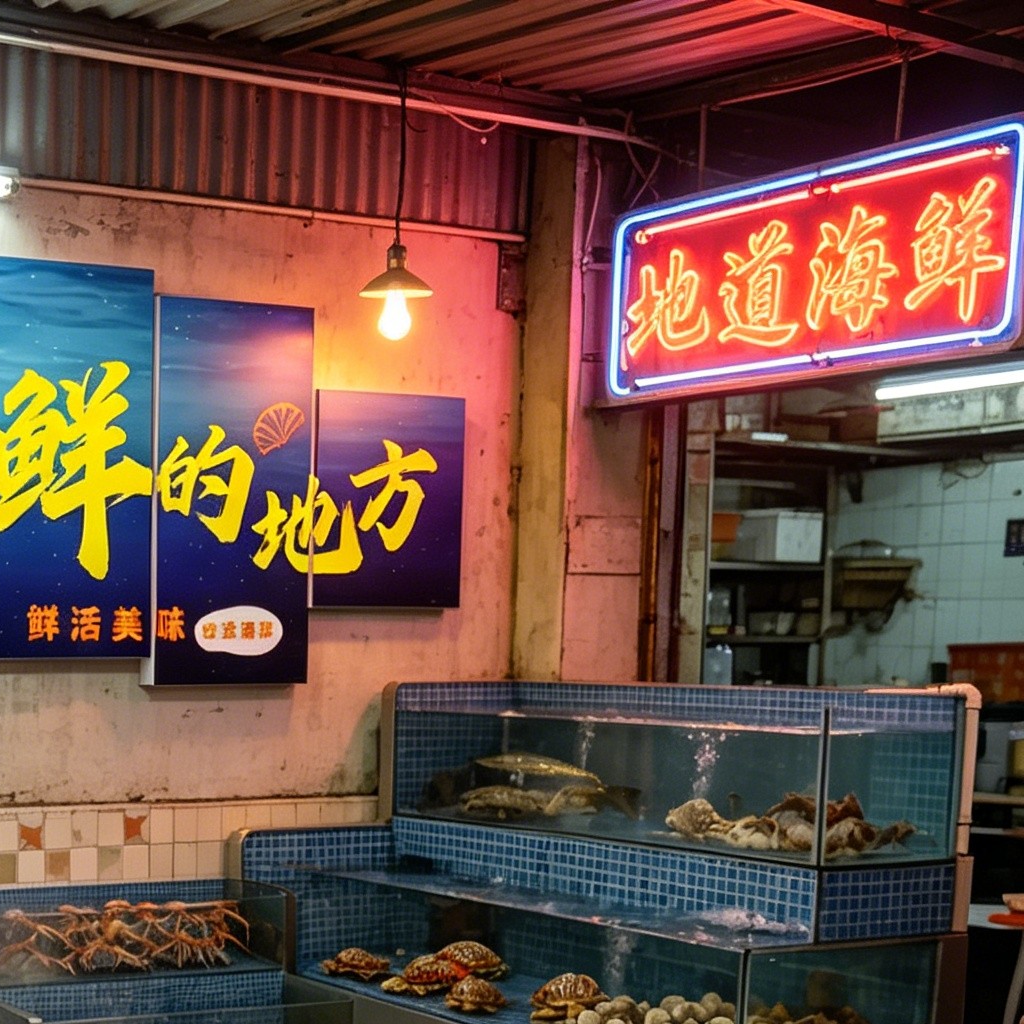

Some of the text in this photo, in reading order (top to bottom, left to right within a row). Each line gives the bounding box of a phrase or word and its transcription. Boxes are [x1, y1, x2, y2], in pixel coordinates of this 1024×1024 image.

[627, 176, 1006, 356] 地道海鲜
[27, 604, 186, 642] 鲜活美味
